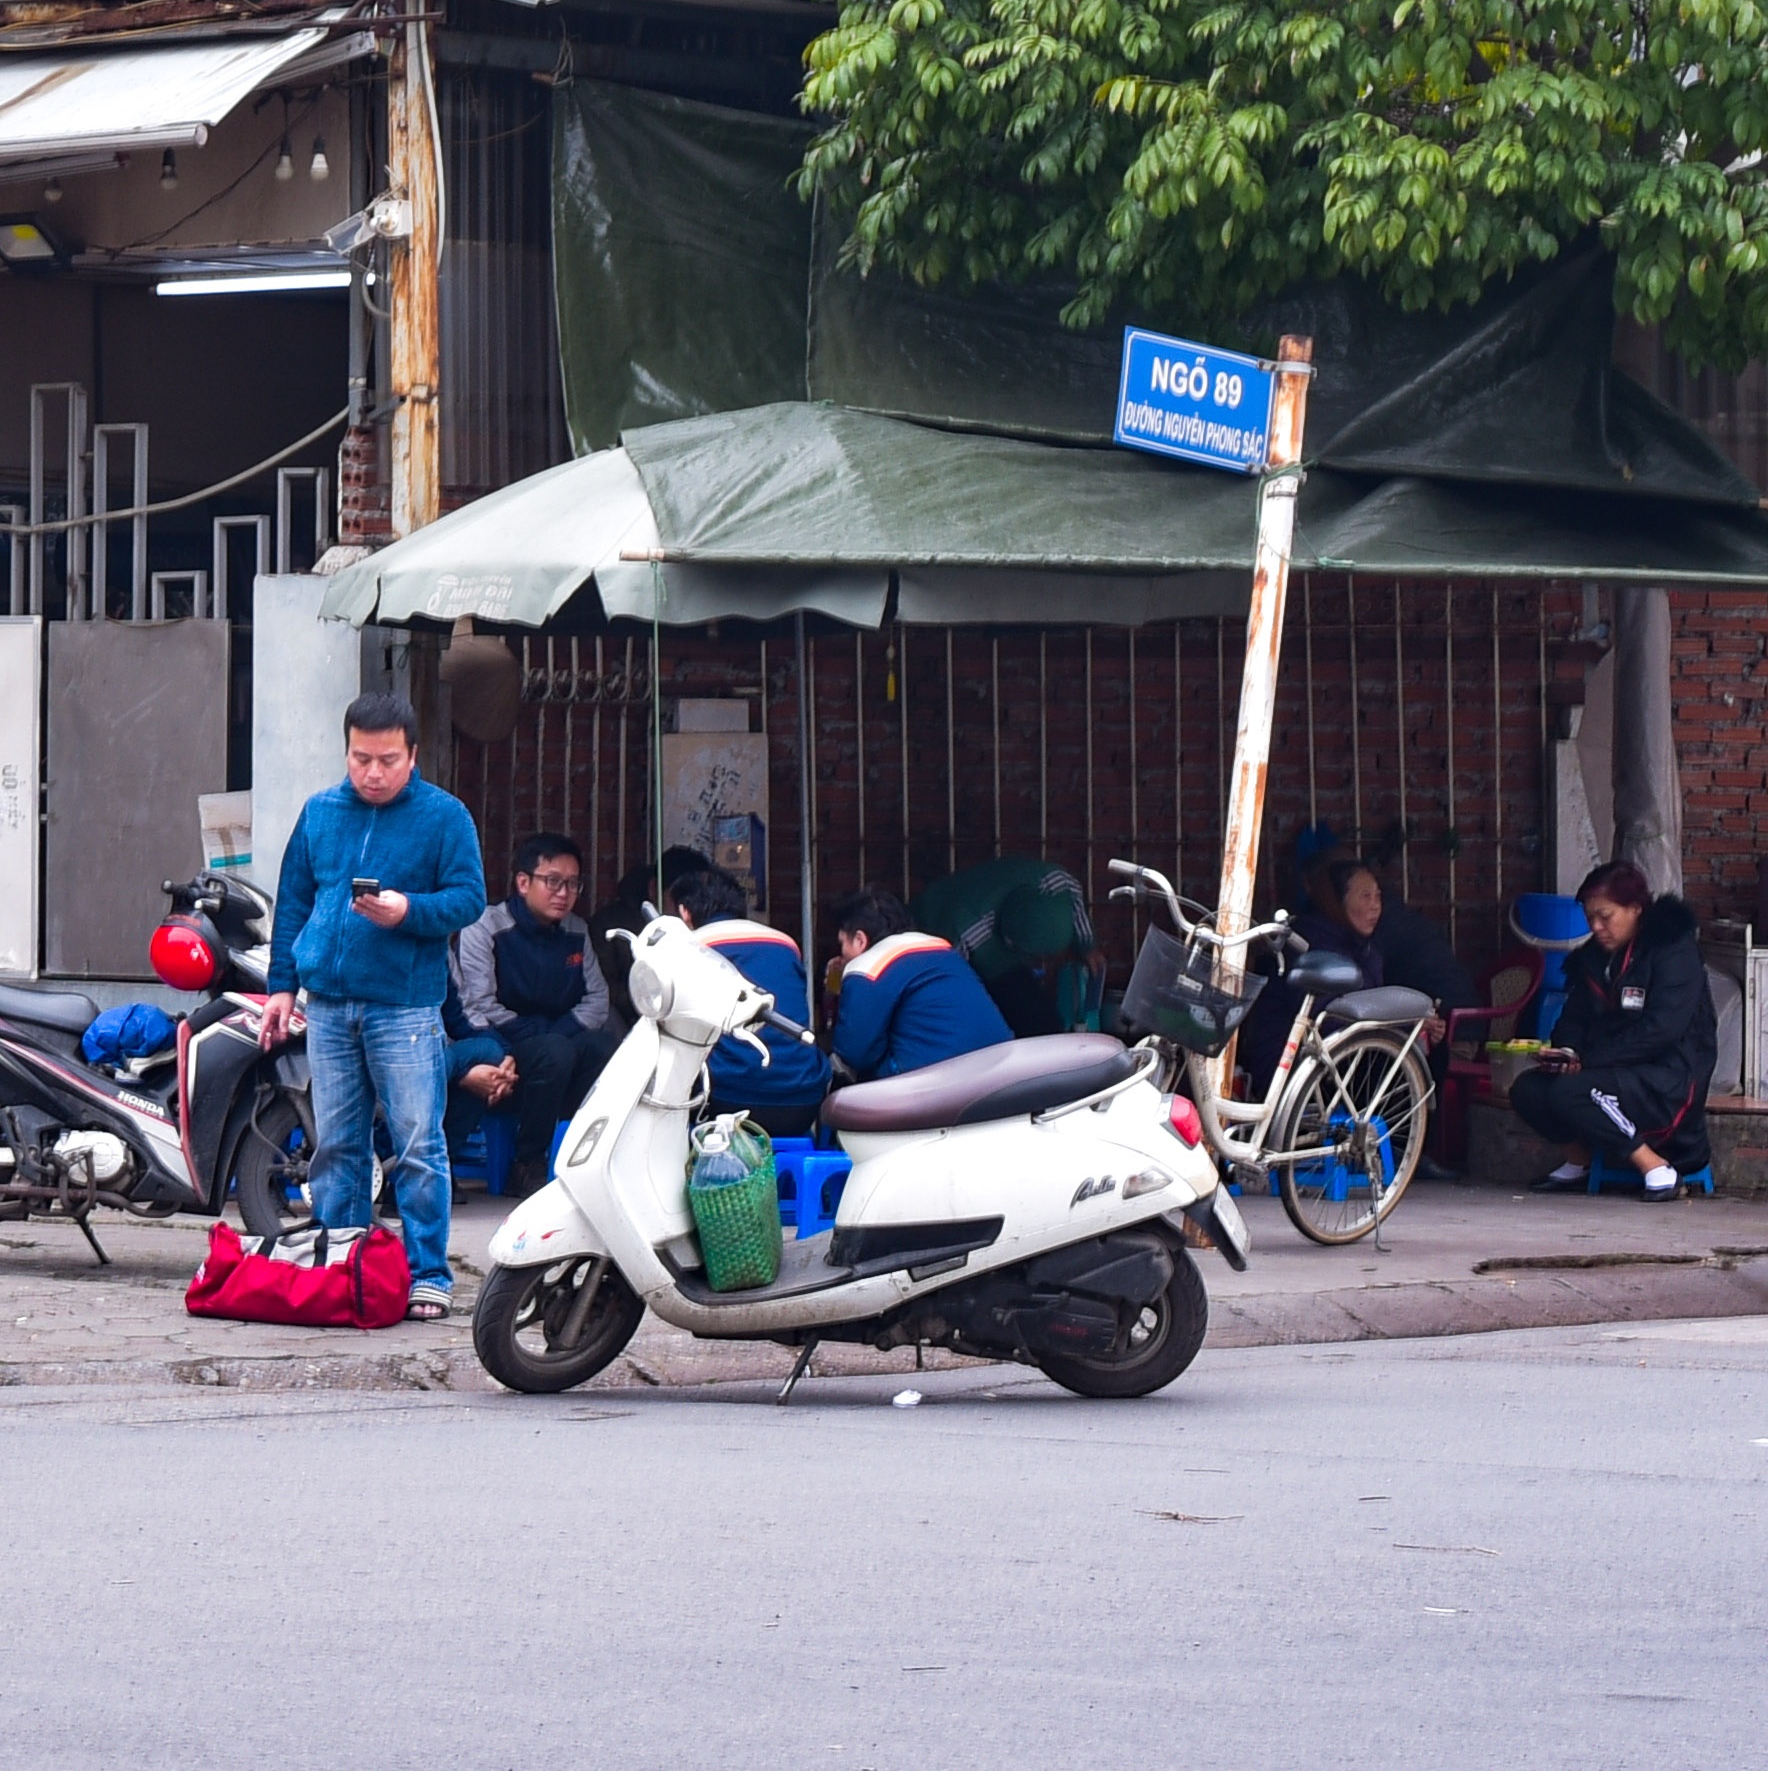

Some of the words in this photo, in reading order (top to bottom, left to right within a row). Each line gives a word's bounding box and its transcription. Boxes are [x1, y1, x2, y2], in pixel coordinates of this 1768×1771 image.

[1150, 356, 1208, 401] NGÕ
[1214, 371, 1242, 409] 89
[1124, 399, 1163, 434] ĐƯỜNG
[1162, 410, 1206, 448] NGUYỄN
[1205, 422, 1241, 456] PHONG
[1241, 426, 1264, 459] SẮC
[117, 1090, 166, 1118] HONDA
